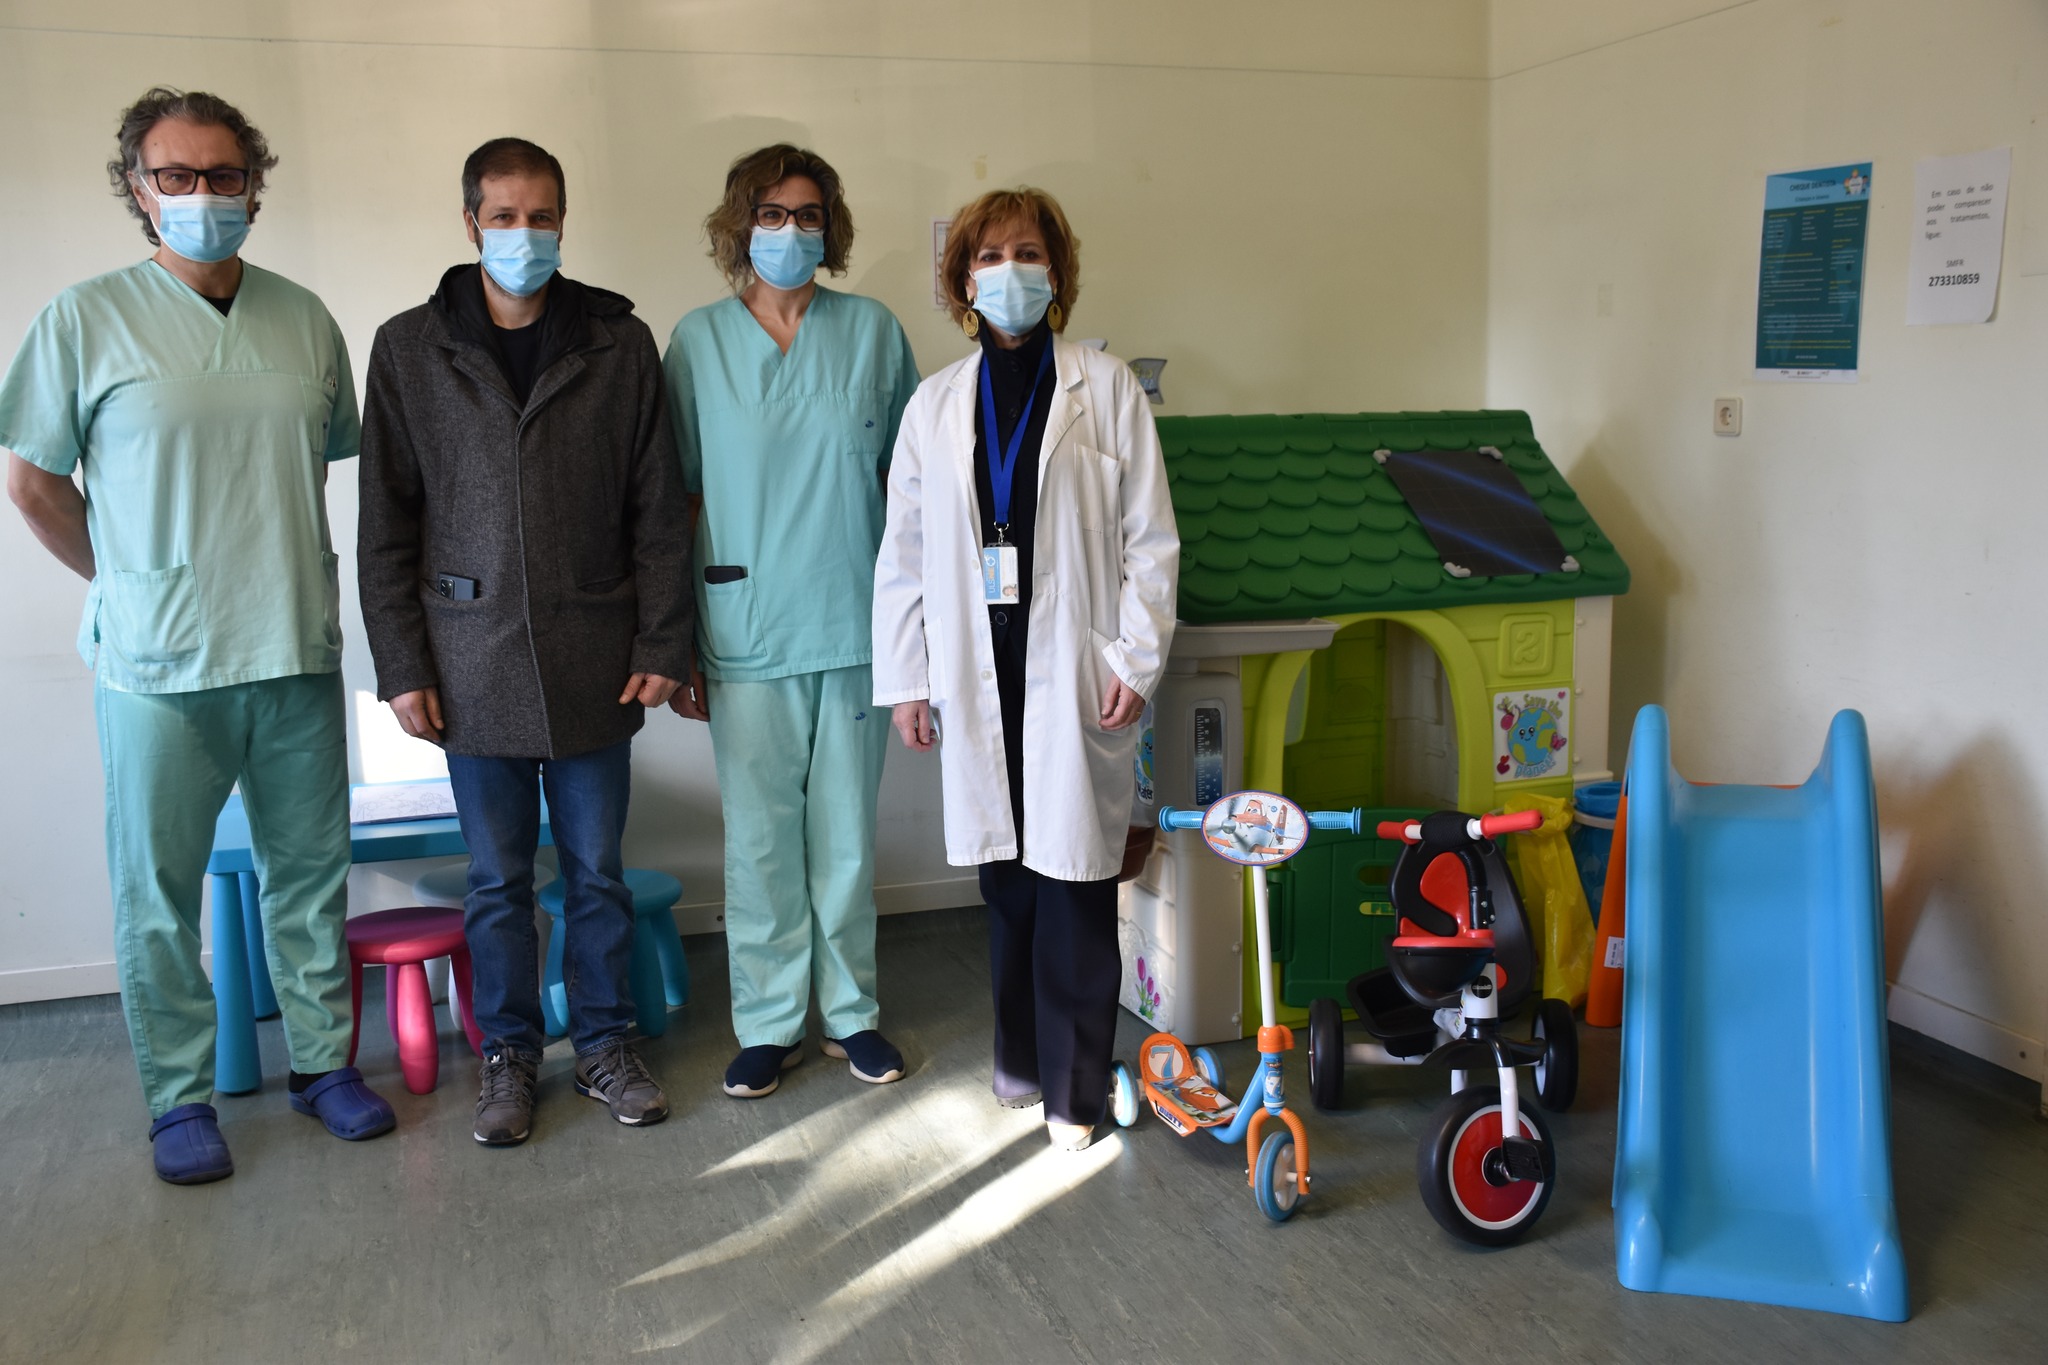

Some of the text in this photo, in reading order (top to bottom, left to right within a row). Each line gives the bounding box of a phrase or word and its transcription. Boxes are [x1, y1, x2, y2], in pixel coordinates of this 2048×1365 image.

[1931, 190, 1941, 198] Em
[1966, 186, 1975, 194] de
[1927, 199, 1992, 213] poder comparecer
[1928, 273, 1980, 287] 273310859
[1513, 629, 1541, 664] 2
[1151, 1044, 1175, 1078] 7
[1159, 1106, 1182, 1127] DUSTY
